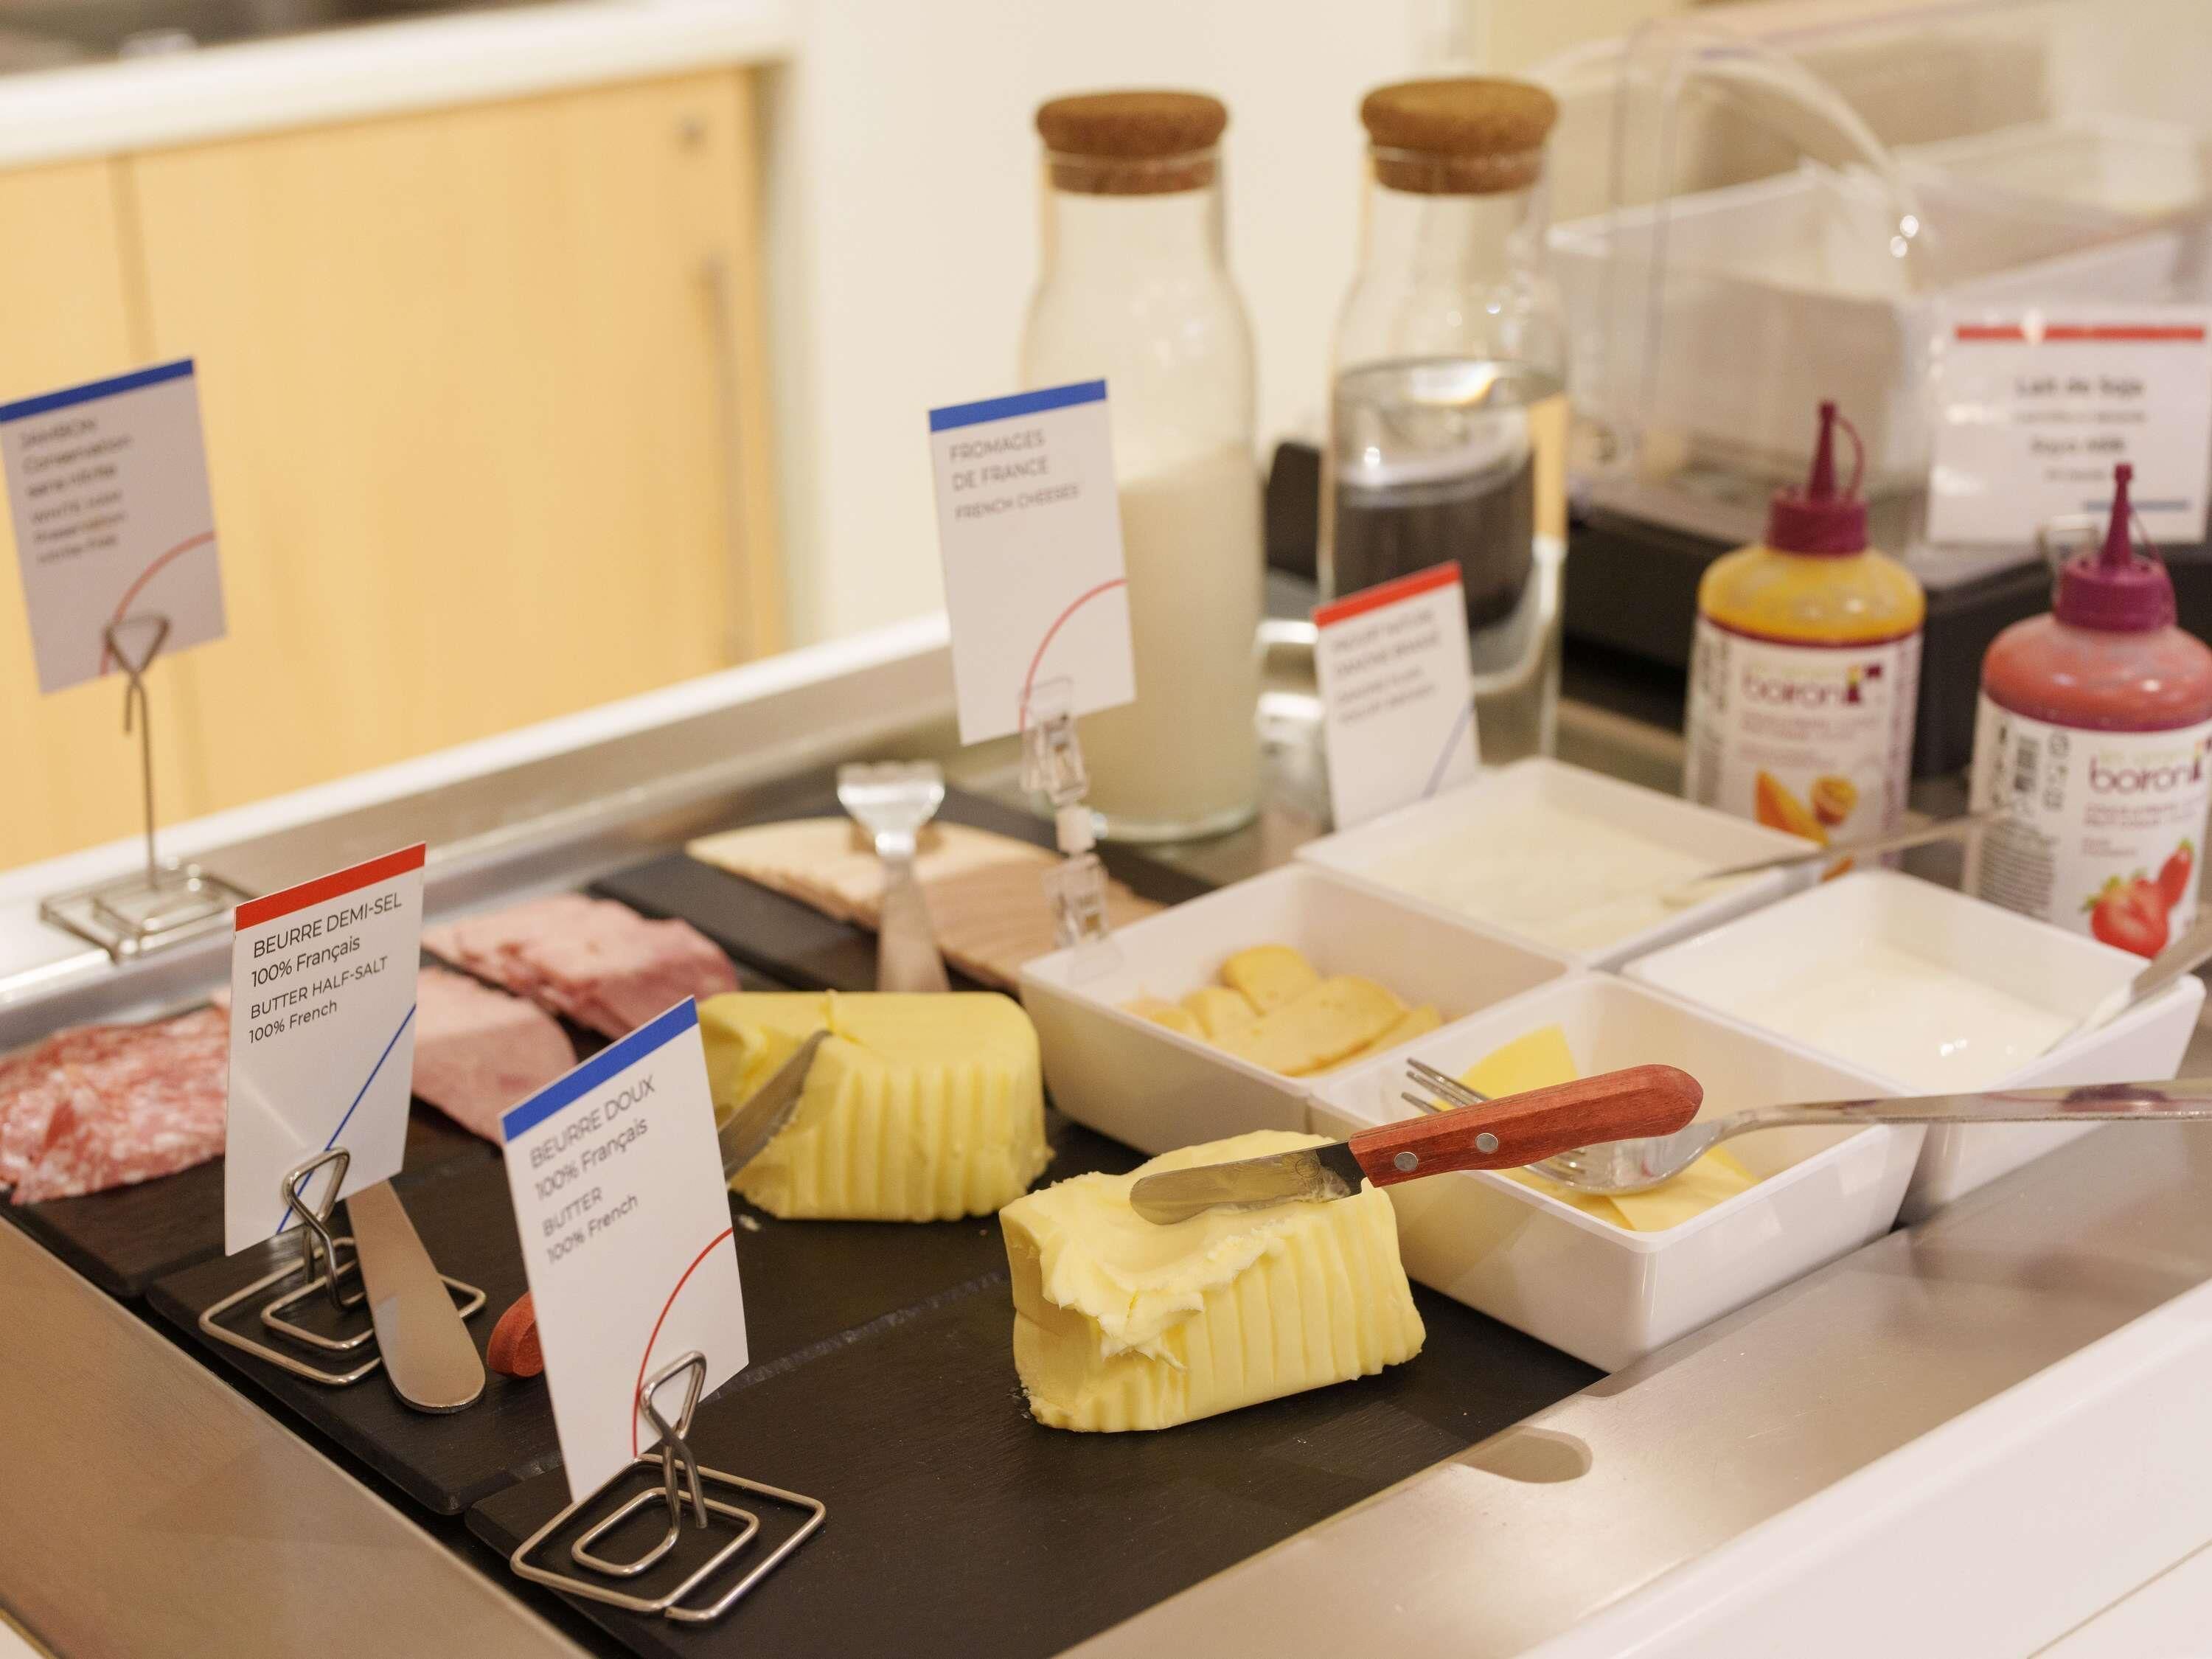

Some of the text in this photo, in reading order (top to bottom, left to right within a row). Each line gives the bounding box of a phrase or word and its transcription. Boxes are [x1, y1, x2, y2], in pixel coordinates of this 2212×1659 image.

[950, 428, 1046, 461] FROMAGES
[953, 455, 1048, 491] DE FRANCE
[956, 482, 1079, 518] FRENCH CHEESES
[254, 892, 402, 959] BEURRE DEMI-SEL
[251, 936, 361, 987] 100% Français
[251, 956, 388, 1019] BUTTER HALF-SALT
[248, 999, 337, 1044] 100% French
[530, 1074, 655, 1169] BEURRE DOUX
[535, 1117, 649, 1200] 100% Français
[541, 1186, 602, 1237] BUTTER
[546, 1194, 639, 1265] 100% French
